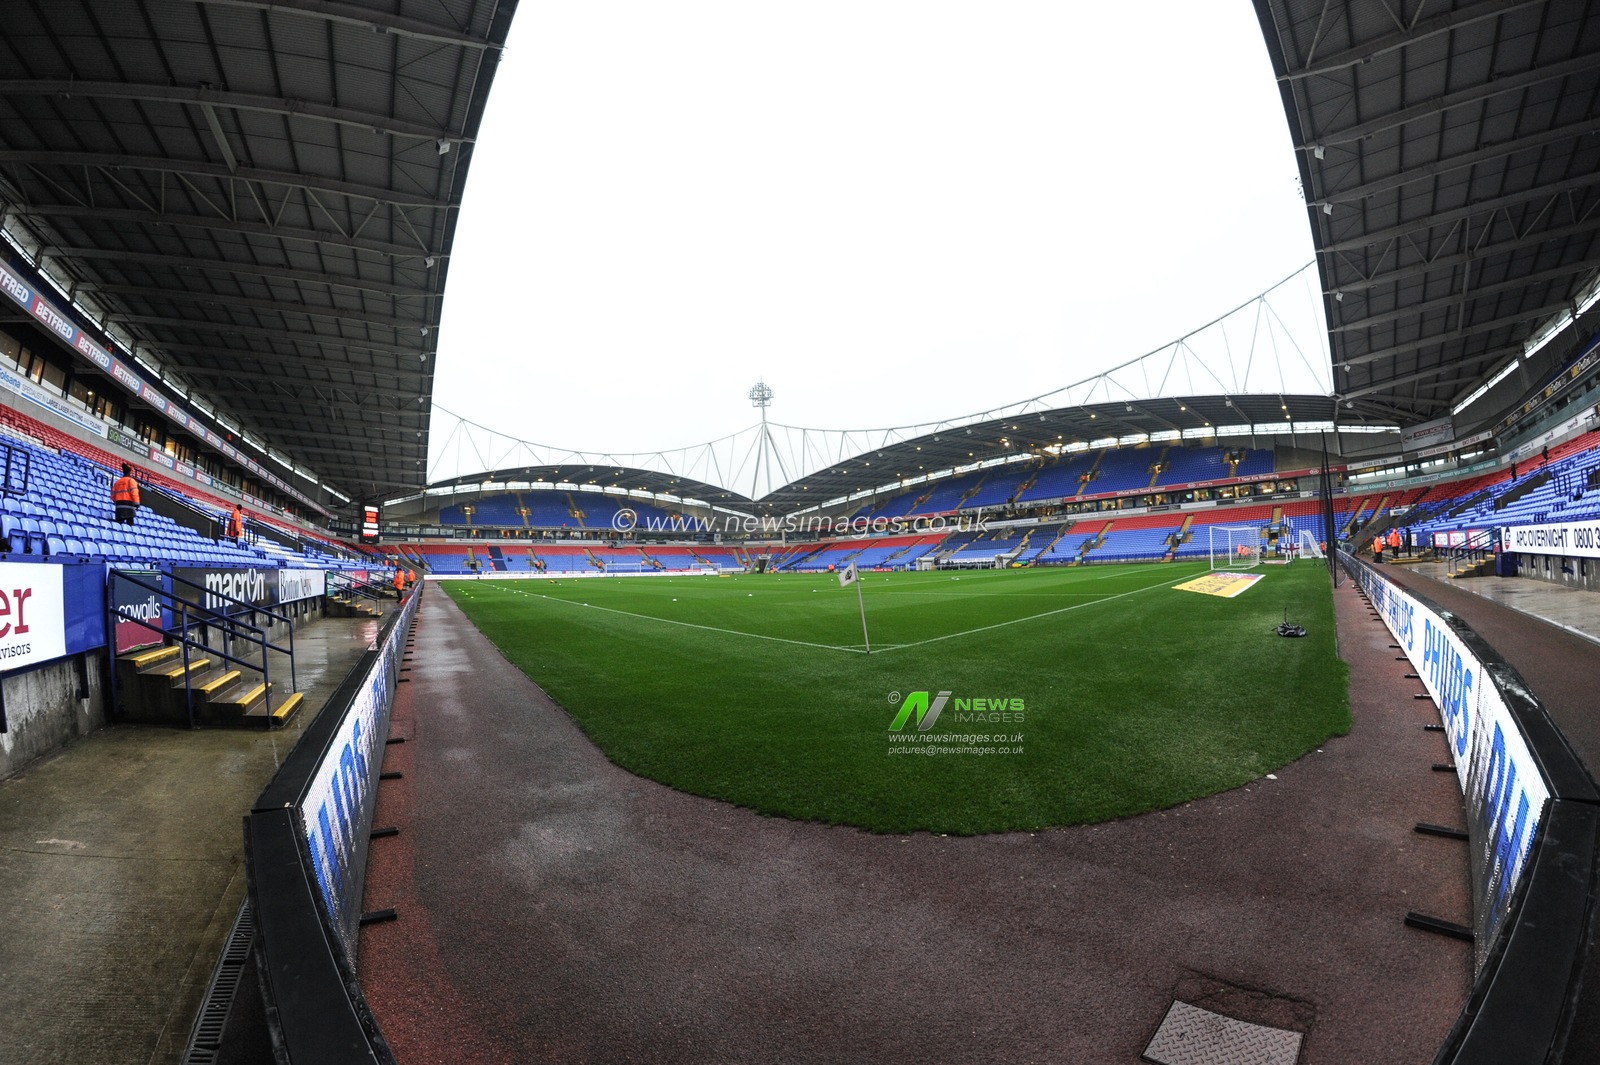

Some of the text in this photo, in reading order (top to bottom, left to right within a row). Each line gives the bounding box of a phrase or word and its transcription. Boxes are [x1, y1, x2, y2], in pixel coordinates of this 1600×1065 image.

[35, 302, 73, 339] BETFRED
[78, 336, 110, 368] BETFRED
[0, 368, 21, 388] olsana
[114, 364, 140, 391] BETFRED
[144, 388, 166, 409] BETFRED
[152, 450, 174, 468] BETFRED
[1528, 528, 1568, 548] OVERNIGHT
[1574, 527, 1594, 549] 0800
[118, 595, 160, 624] cowgills
[0, 643, 31, 659] visors
[1423, 618, 1473, 757] PHILIPS
